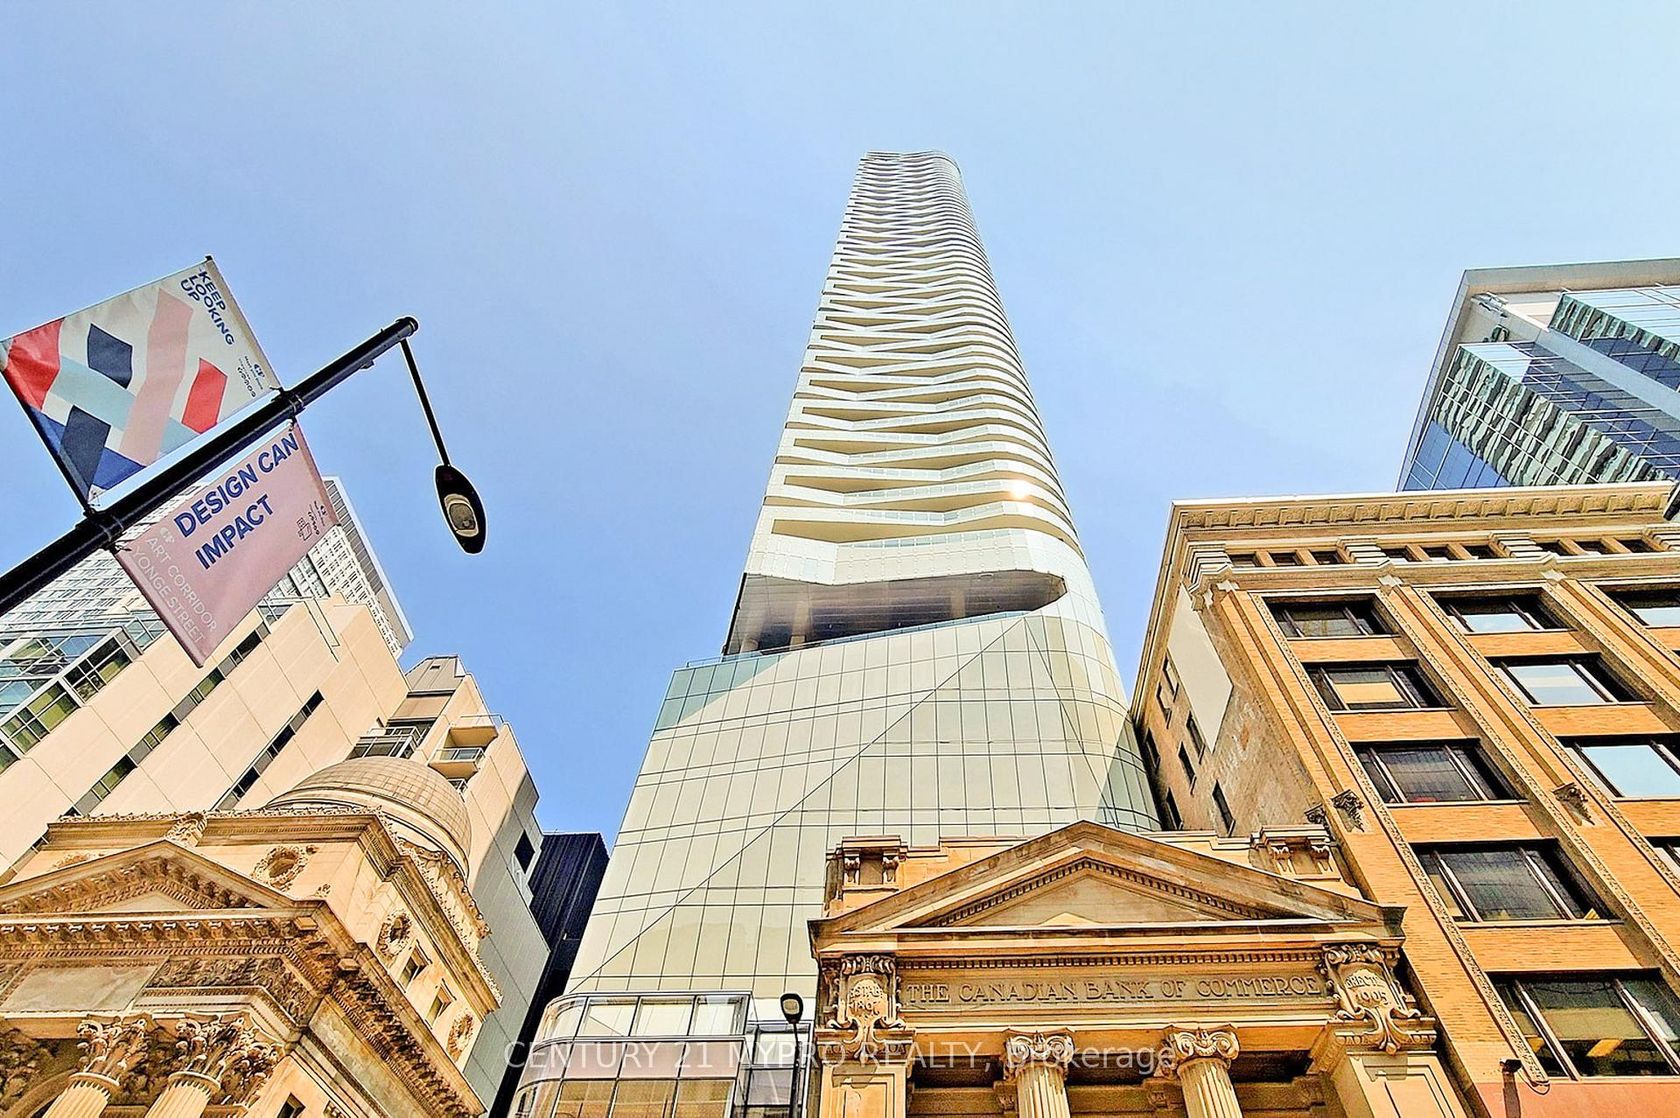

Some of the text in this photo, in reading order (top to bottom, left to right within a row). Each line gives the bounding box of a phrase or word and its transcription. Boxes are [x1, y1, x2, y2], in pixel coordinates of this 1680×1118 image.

[180, 279, 201, 302] UP
[189, 275, 235, 345] LOOKING
[198, 271, 226, 311] KEEP
[174, 463, 259, 538] DESIGN
[258, 433, 299, 473] CAN
[195, 494, 273, 570] IMPACT
[132, 545, 207, 642] YONGE STREET
[147, 538, 217, 632] ART CORRIDOR
[906, 976, 1321, 1002] THE CANADIAN BANK OF COMMERCE
